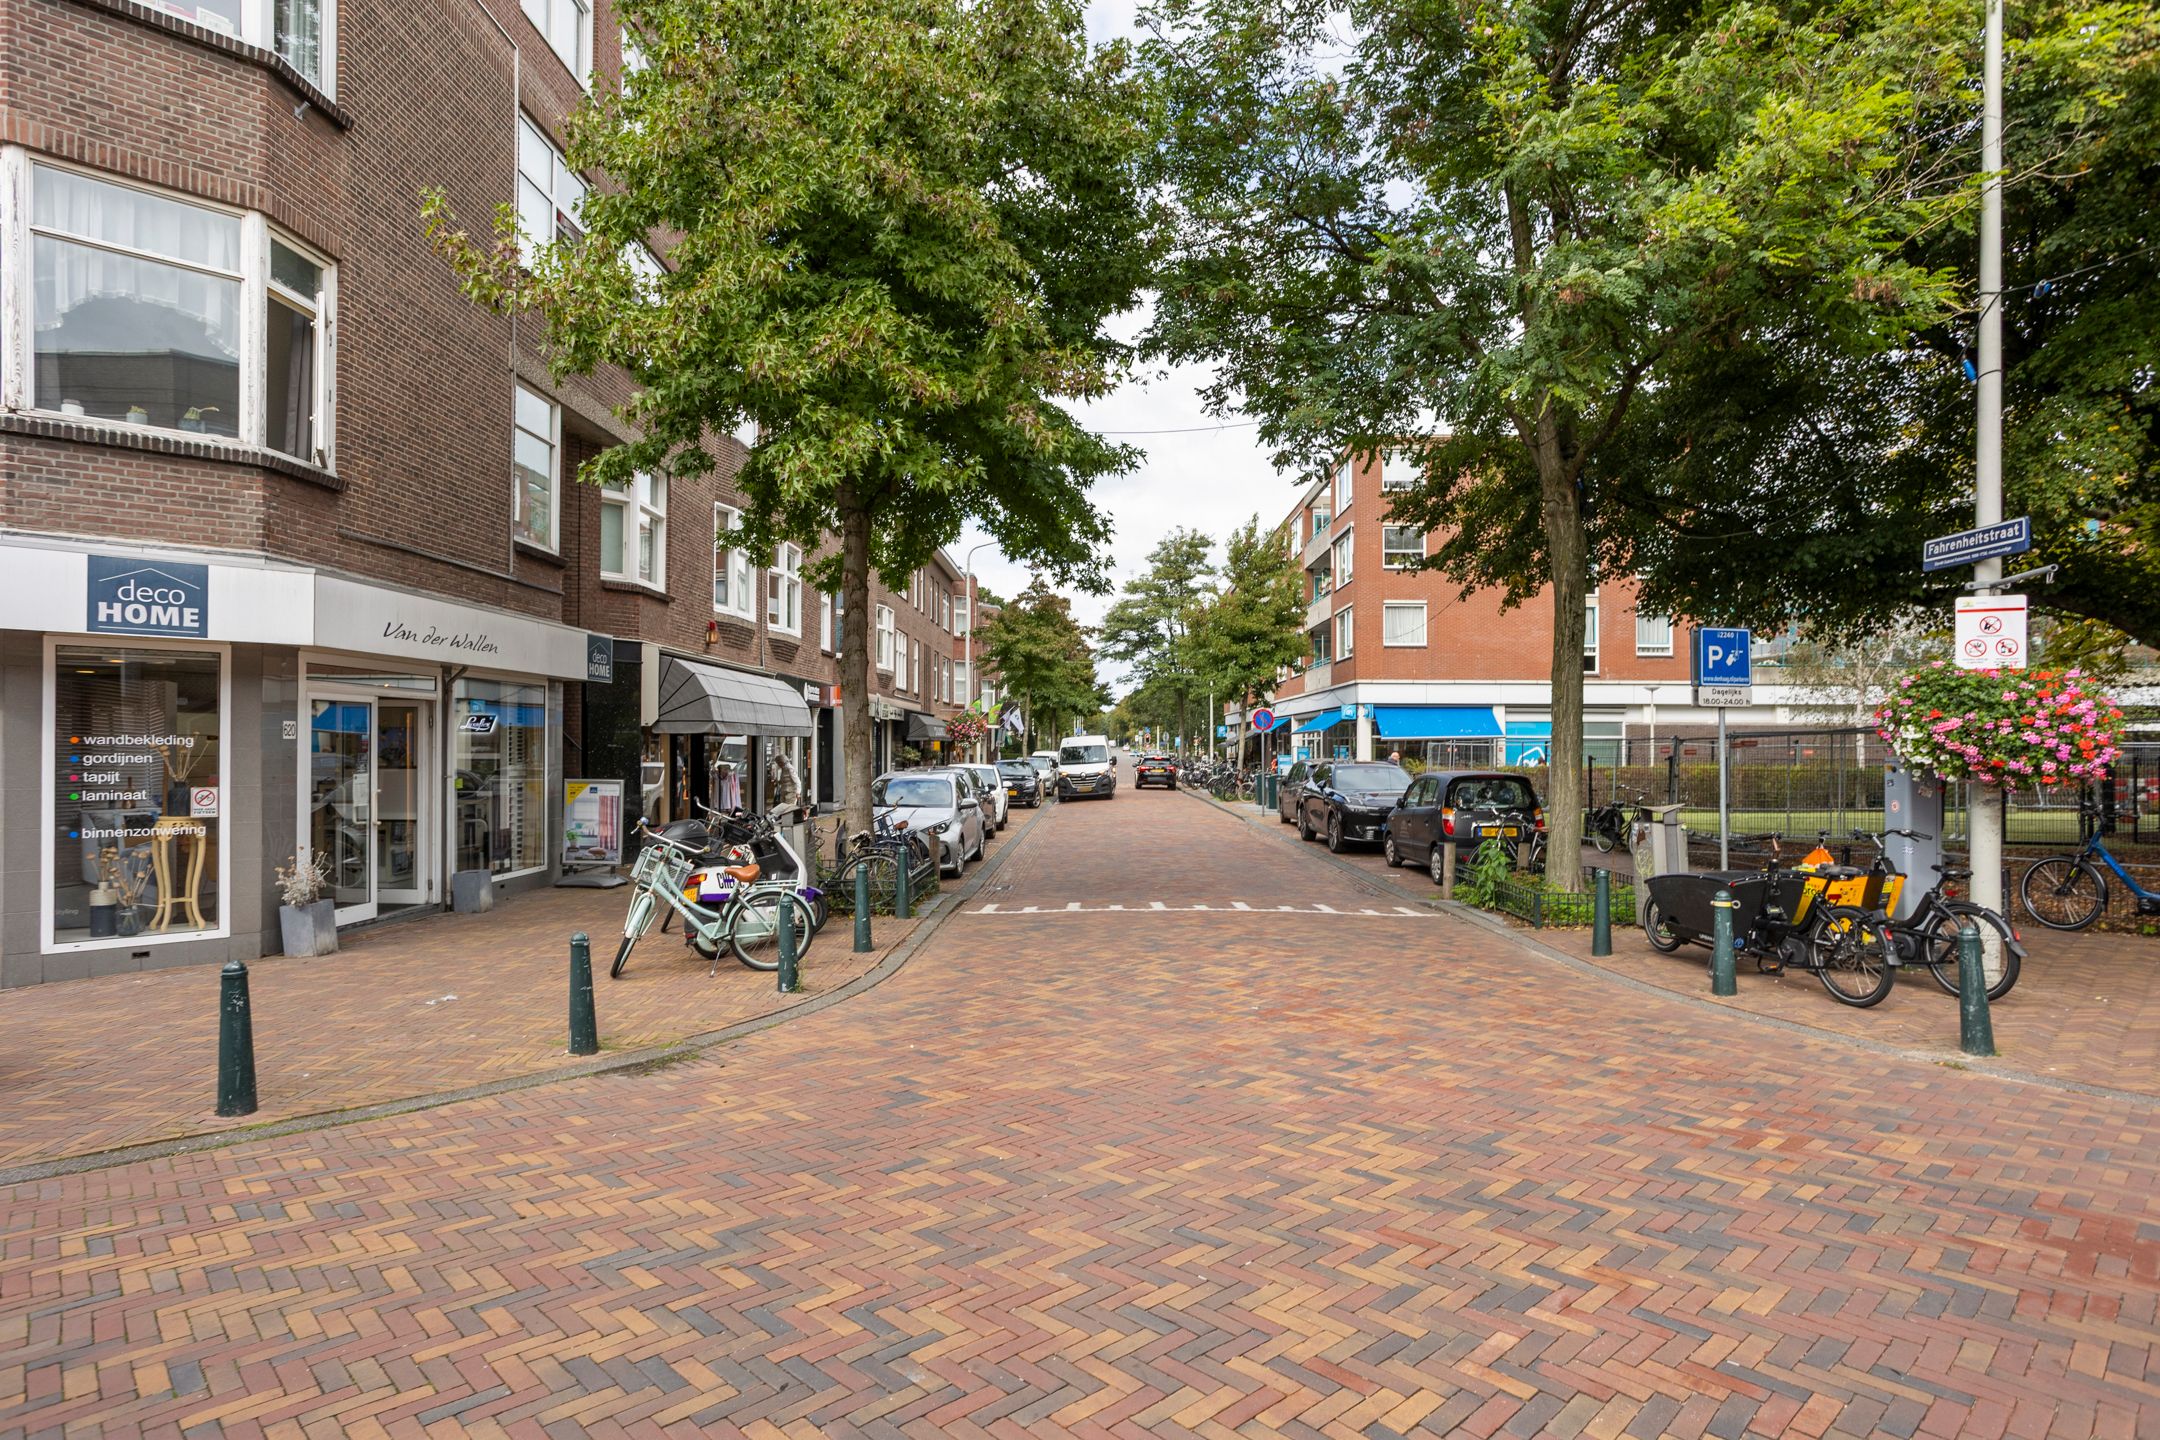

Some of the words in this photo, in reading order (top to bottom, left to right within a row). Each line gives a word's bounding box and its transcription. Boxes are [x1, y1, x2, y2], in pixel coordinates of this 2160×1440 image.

[1927, 523, 2020, 556] Fahrenheitstraat
[117, 579, 186, 605] deco
[98, 601, 200, 628] HOME
[383, 622, 418, 643] Van
[422, 626, 449, 646] der
[450, 634, 499, 654] Wallen
[592, 649, 608, 664] deco
[1708, 645, 1724, 670] P
[589, 661, 611, 678] HOME
[1711, 688, 1743, 697] Dagelijks
[284, 723, 296, 737] 620
[83, 734, 194, 748] wandbekleding
[82, 752, 153, 766] gordijnen
[82, 772, 120, 785] tapijt
[82, 790, 147, 801] laminaat
[82, 826, 206, 839] binnenzonwering
